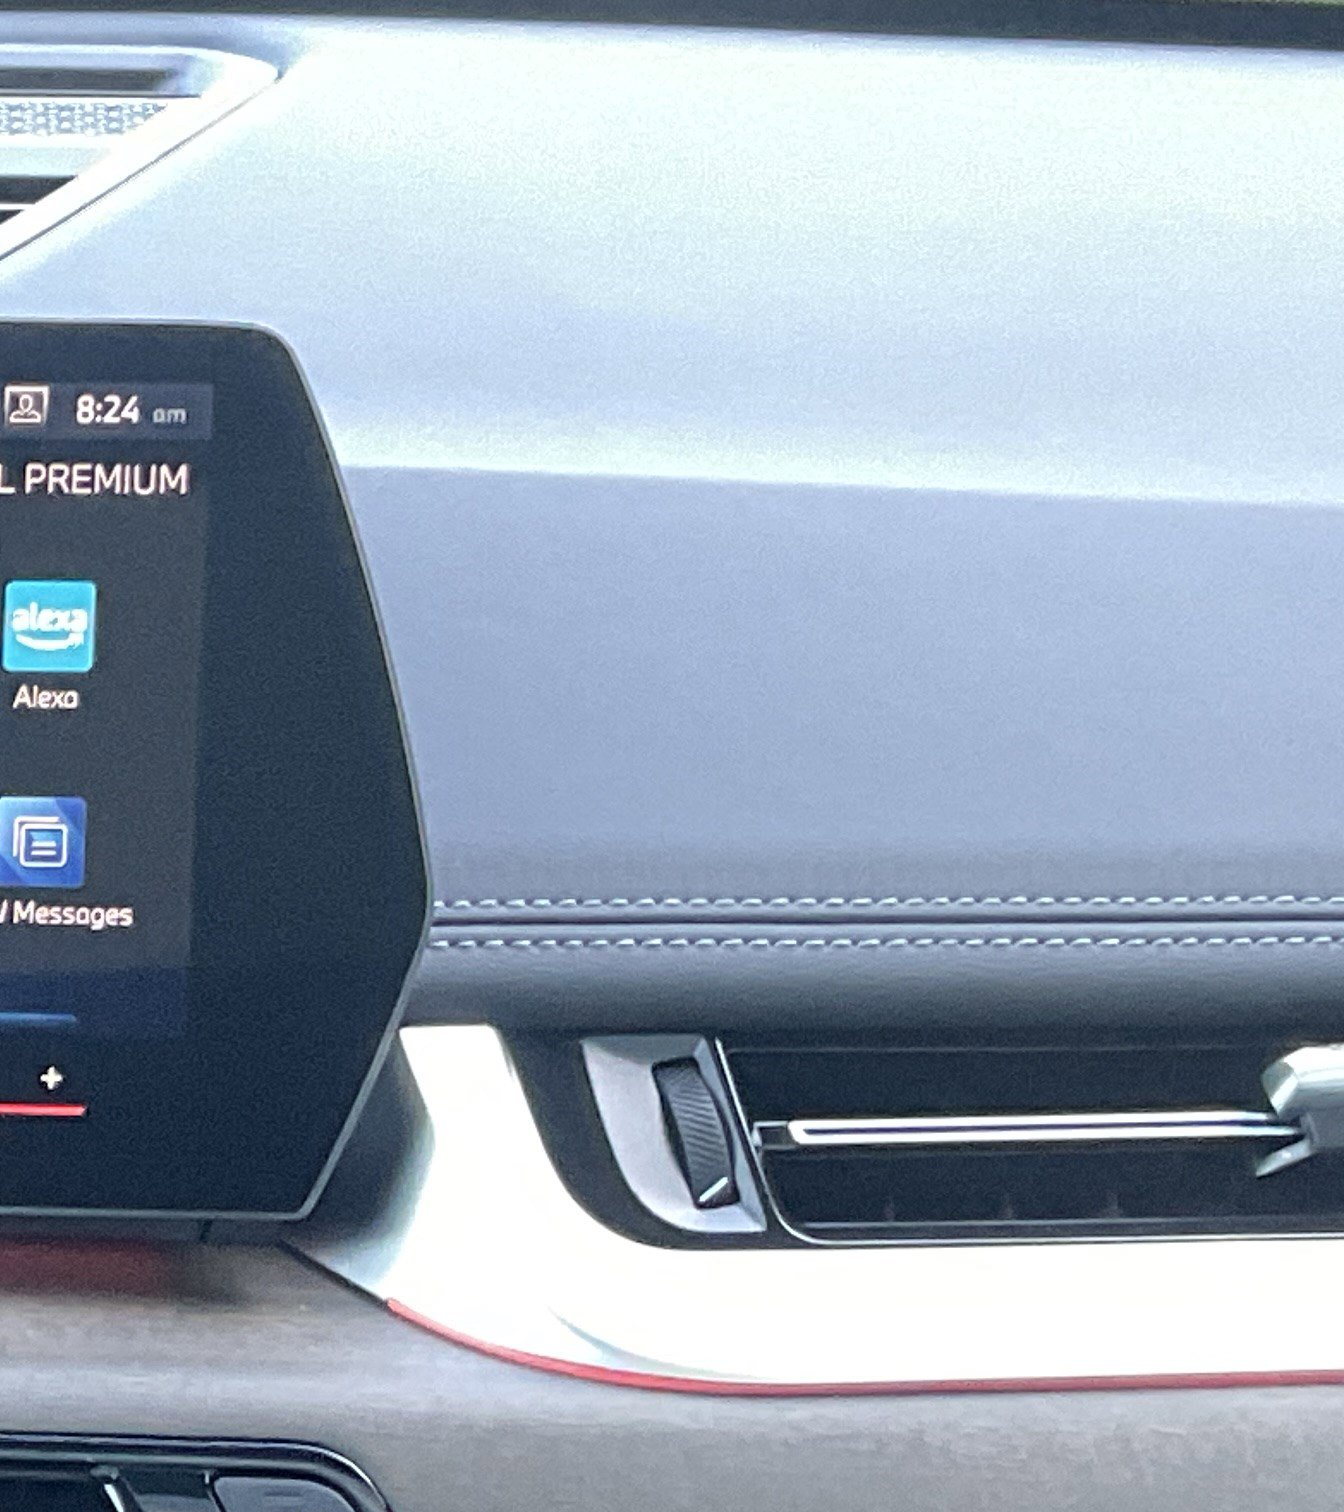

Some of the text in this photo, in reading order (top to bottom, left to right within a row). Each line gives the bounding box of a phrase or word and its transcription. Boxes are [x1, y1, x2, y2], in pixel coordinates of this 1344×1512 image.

[75, 395, 187, 425] 8:24 am
[25, 463, 189, 496] PREMIUM
[11, 602, 88, 631] alexa
[13, 684, 79, 710] Alexa
[13, 900, 133, 930] Messages
